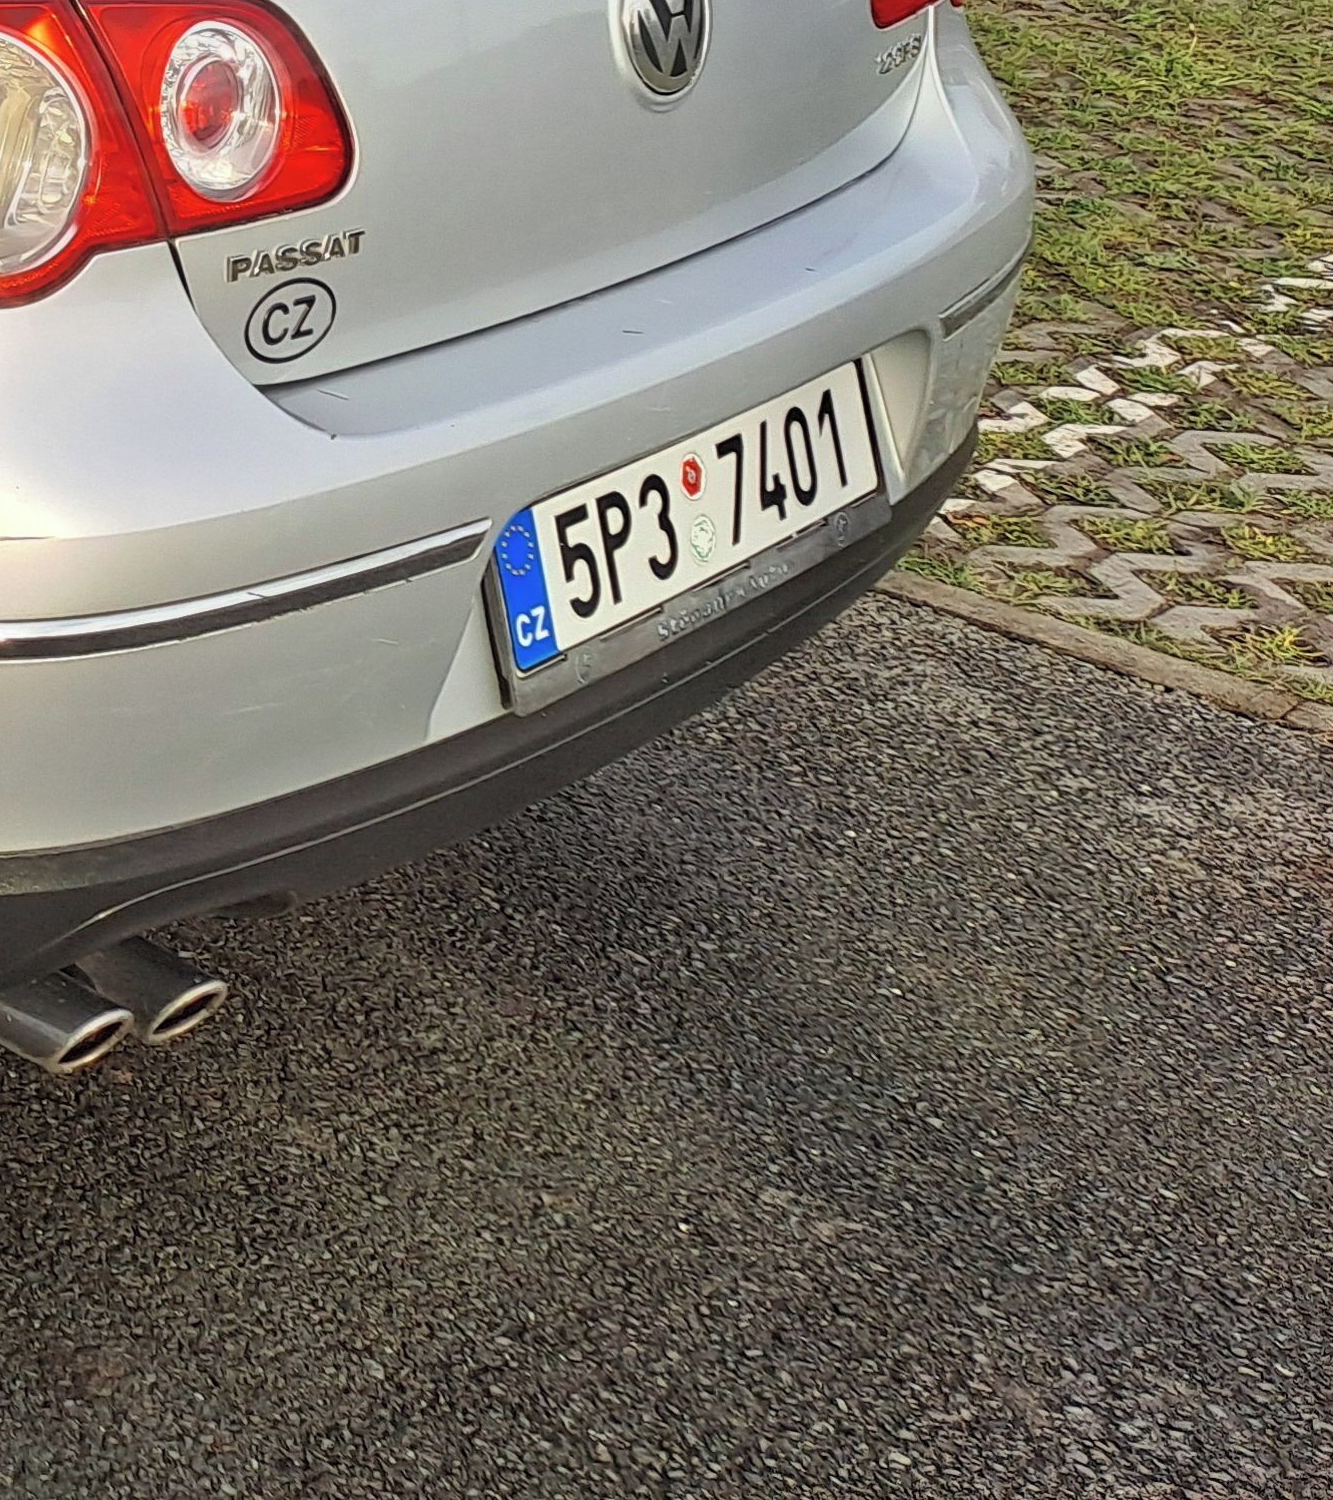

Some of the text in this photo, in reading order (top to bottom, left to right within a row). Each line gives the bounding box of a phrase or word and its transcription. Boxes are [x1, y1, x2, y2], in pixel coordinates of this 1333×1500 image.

[225, 228, 366, 283] PASSAT
[261, 294, 317, 346] CZ
[516, 389, 848, 647] CZ 5P3 7401
